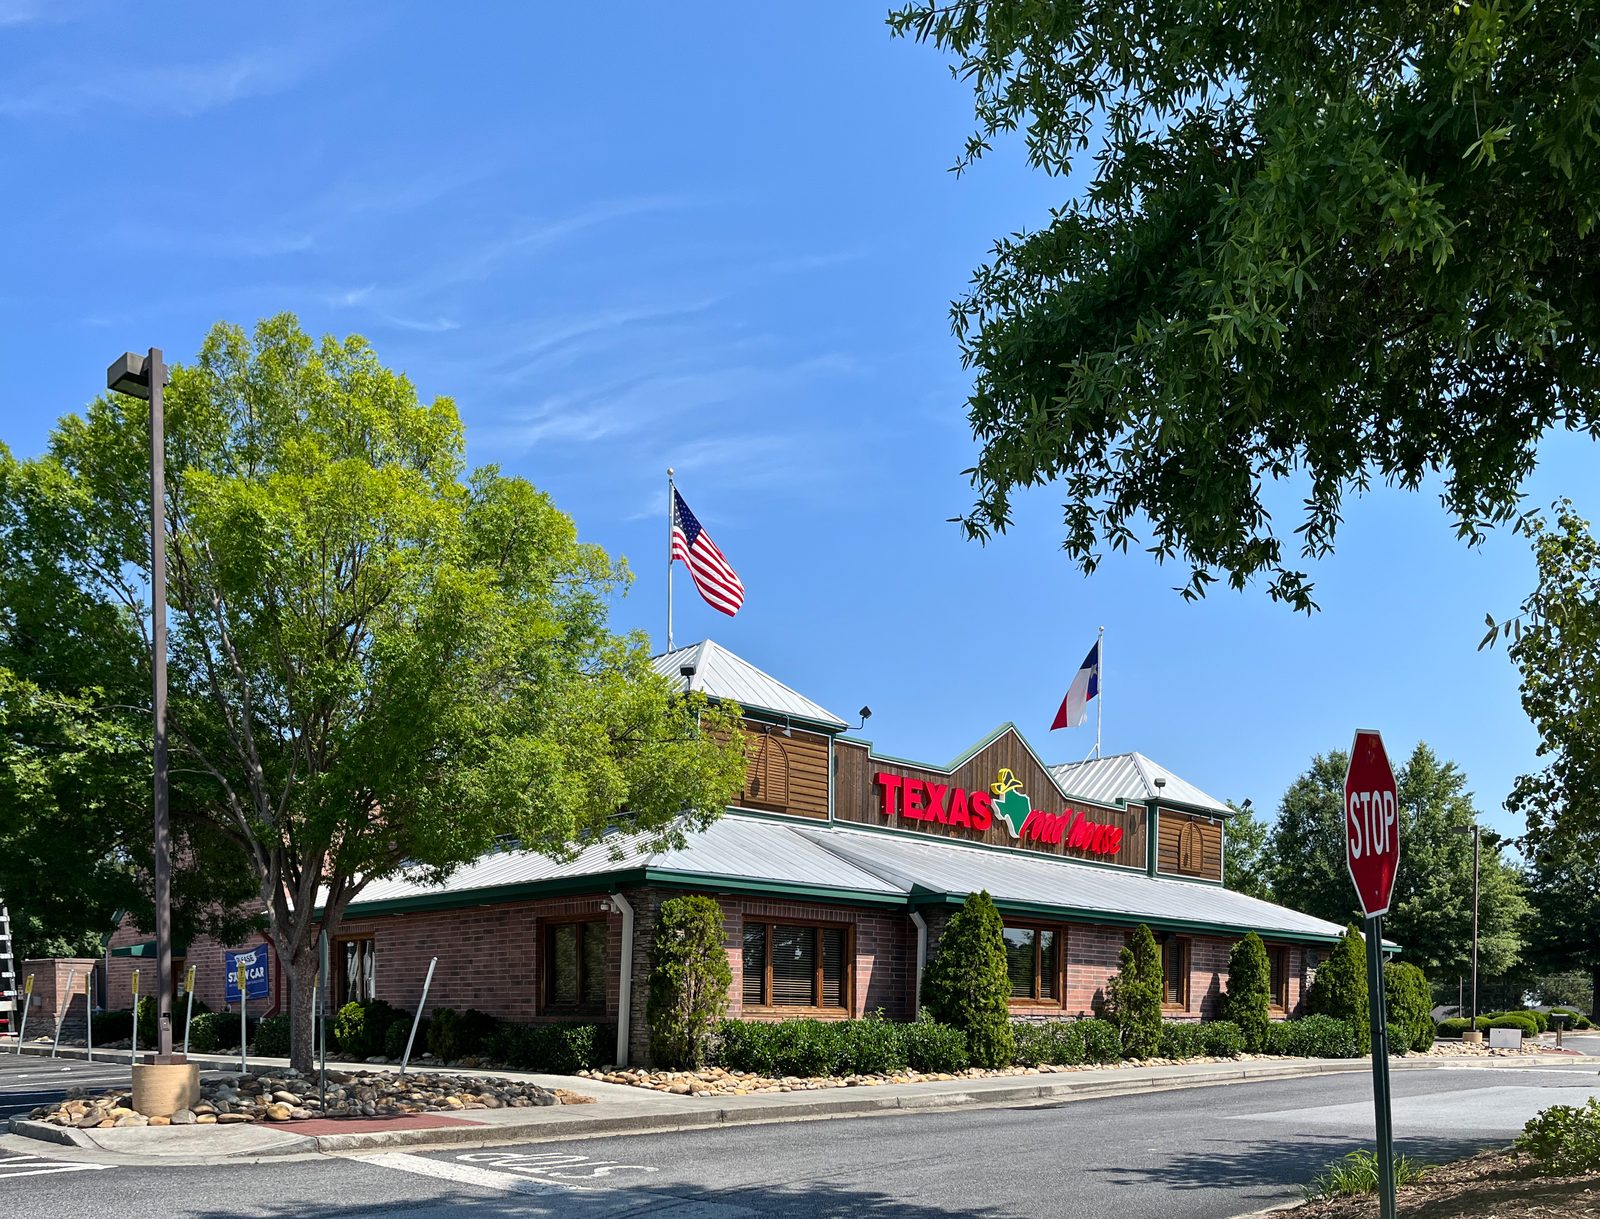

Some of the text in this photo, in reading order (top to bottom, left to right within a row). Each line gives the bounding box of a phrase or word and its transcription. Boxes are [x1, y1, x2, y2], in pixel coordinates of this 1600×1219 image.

[875, 772, 993, 831] TEXAS
[1350, 790, 1395, 859] STOP
[250, 967, 264, 979] CAR
[456, 1152, 659, 1180] STOP
